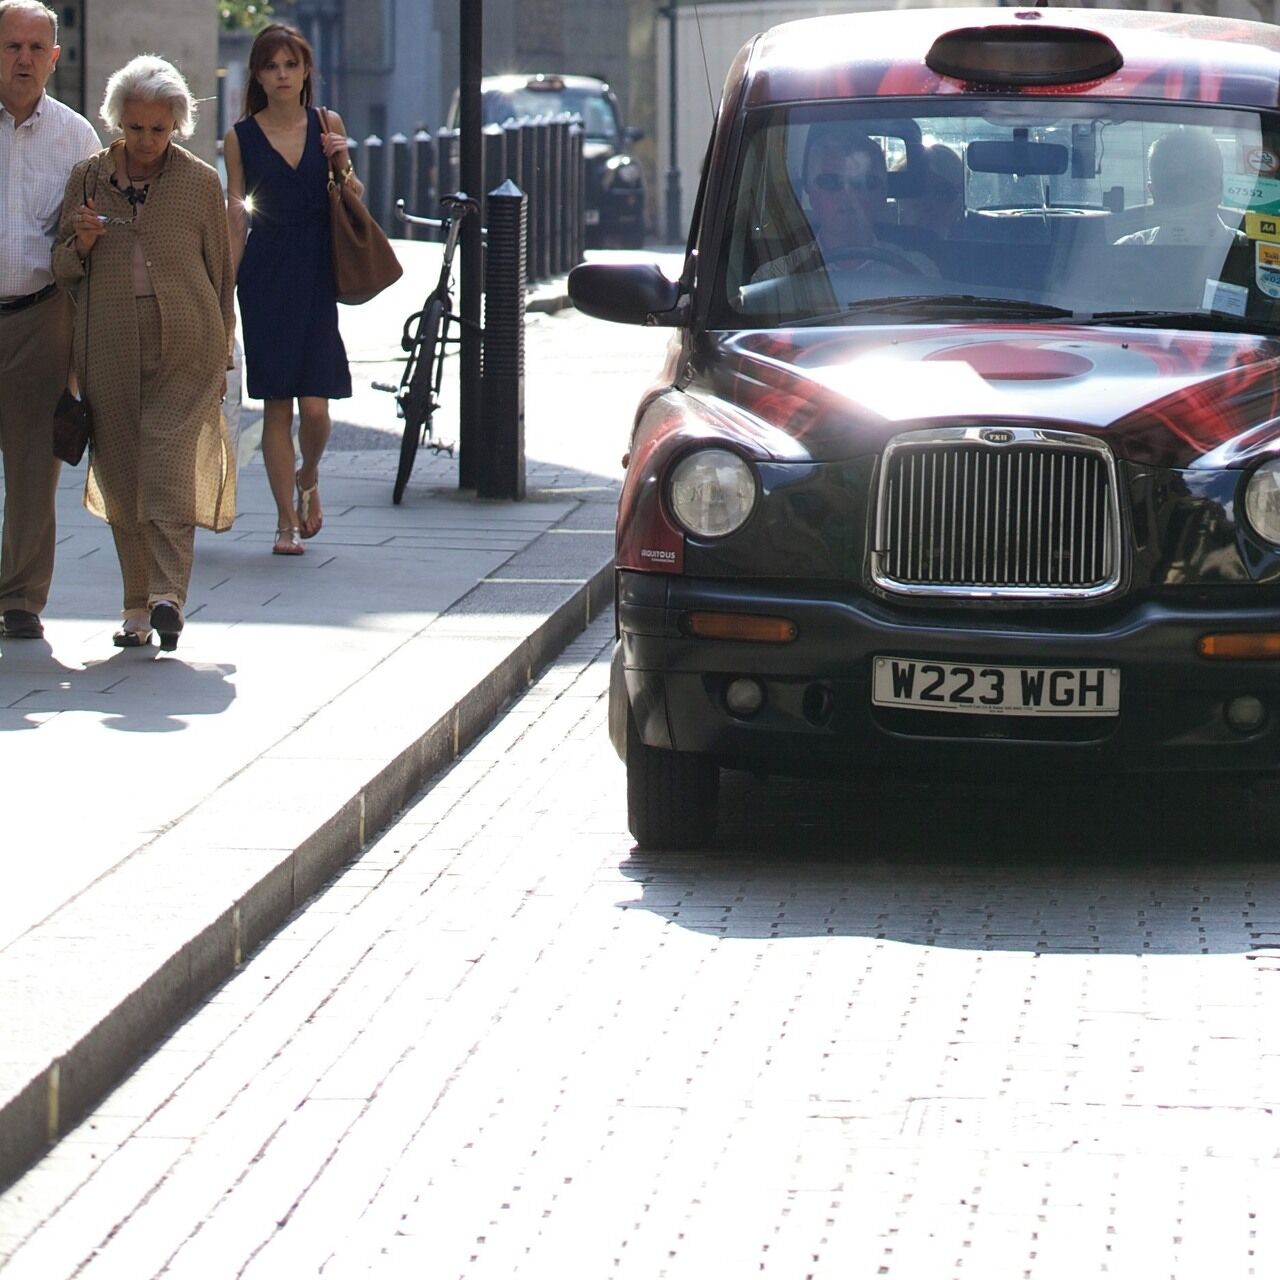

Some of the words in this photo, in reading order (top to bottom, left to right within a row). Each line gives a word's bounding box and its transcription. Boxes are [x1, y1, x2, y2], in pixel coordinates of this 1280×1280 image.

[1262, 223, 1275, 232] AA
[891, 661, 1005, 705] W223
[1020, 670, 1105, 706] WGH
